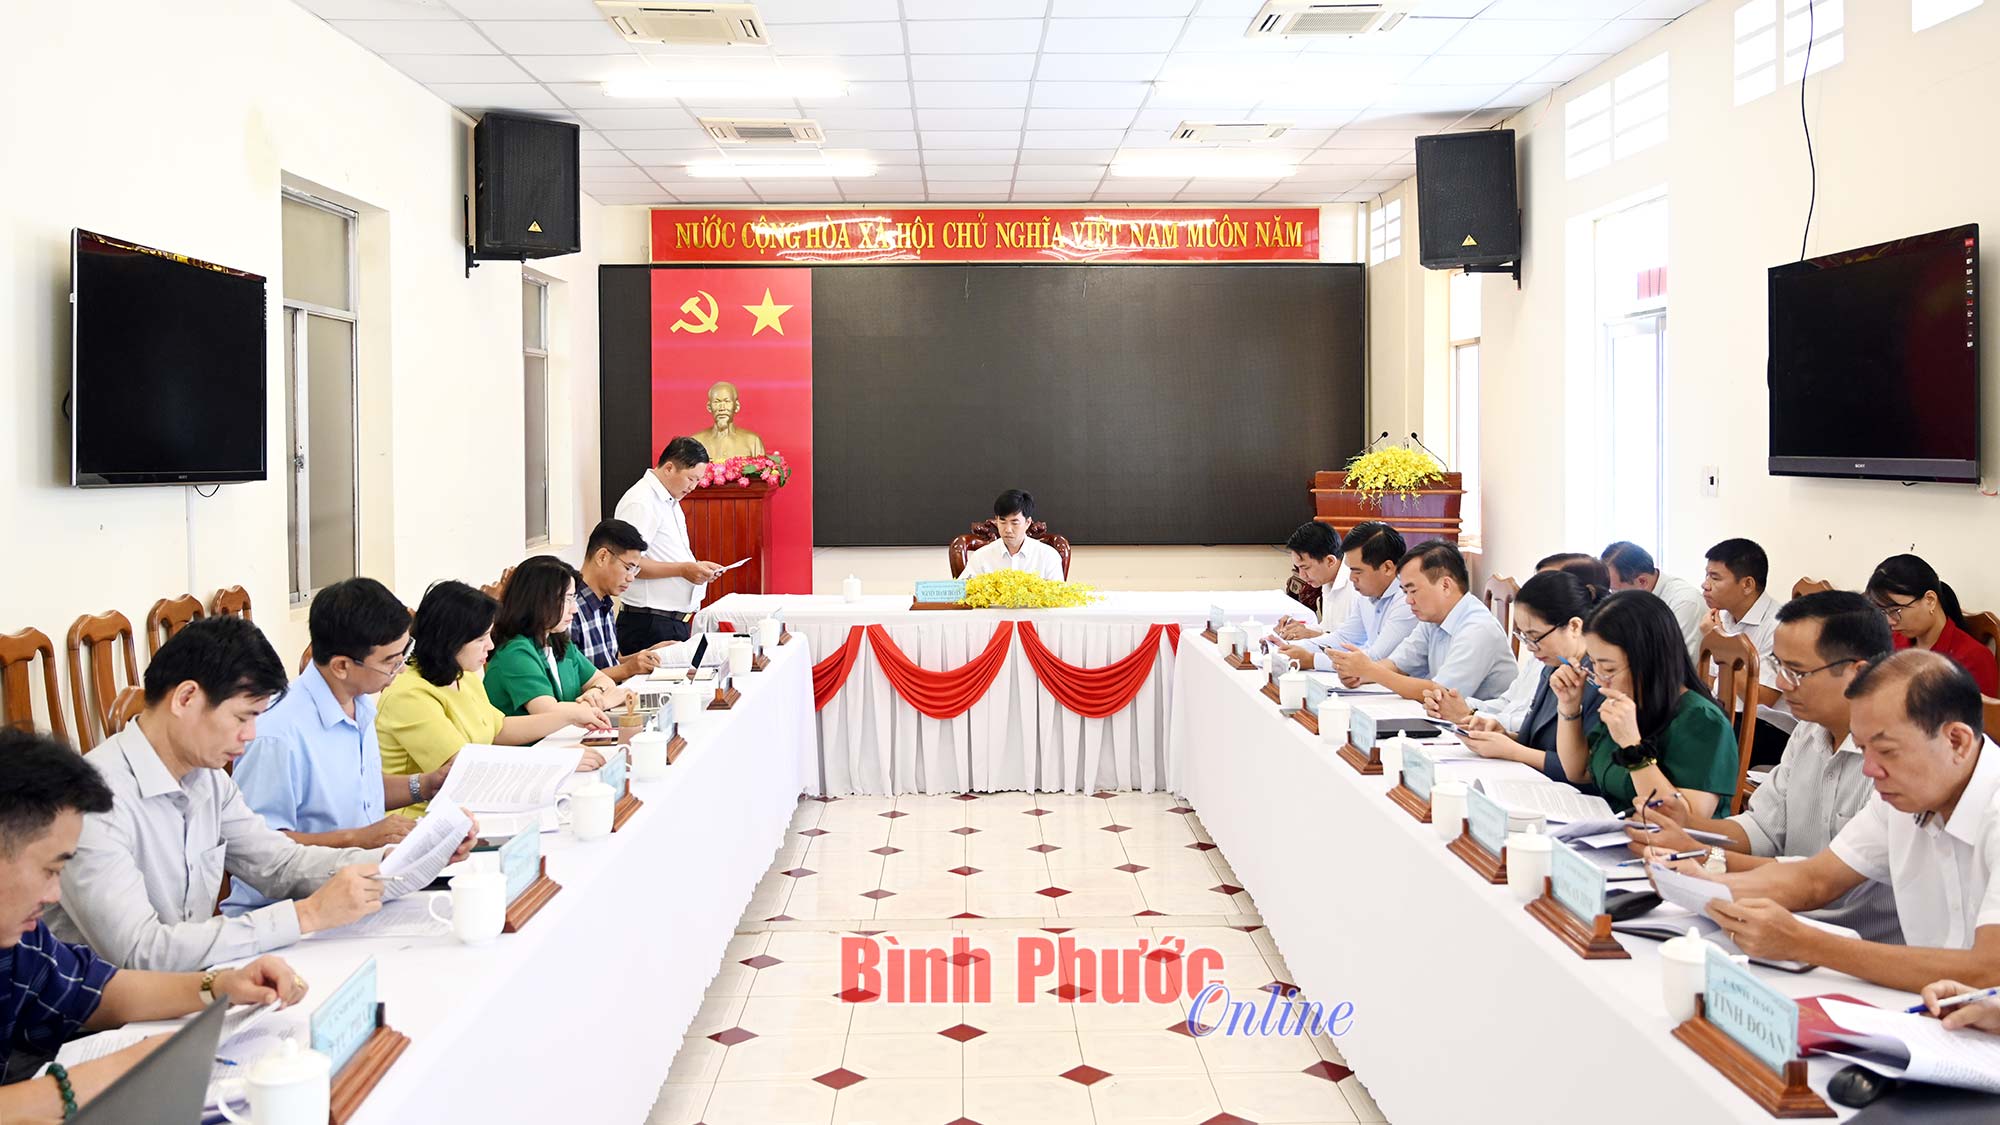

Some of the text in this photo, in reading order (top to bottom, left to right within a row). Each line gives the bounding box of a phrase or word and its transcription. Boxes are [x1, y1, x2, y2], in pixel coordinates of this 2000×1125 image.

[674, 214, 736, 249] NƯỚC
[741, 215, 801, 254] CỘNG
[805, 214, 851, 249] HÒA
[895, 215, 935, 254] HỘI
[942, 212, 987, 249] CHỦ
[995, 215, 1066, 249] NGHĨA
[1070, 214, 1122, 253] VIỆT
[1129, 220, 1179, 249] NAM
[1186, 214, 1249, 249] MUÔN
[1254, 215, 1304, 249] NĂM
